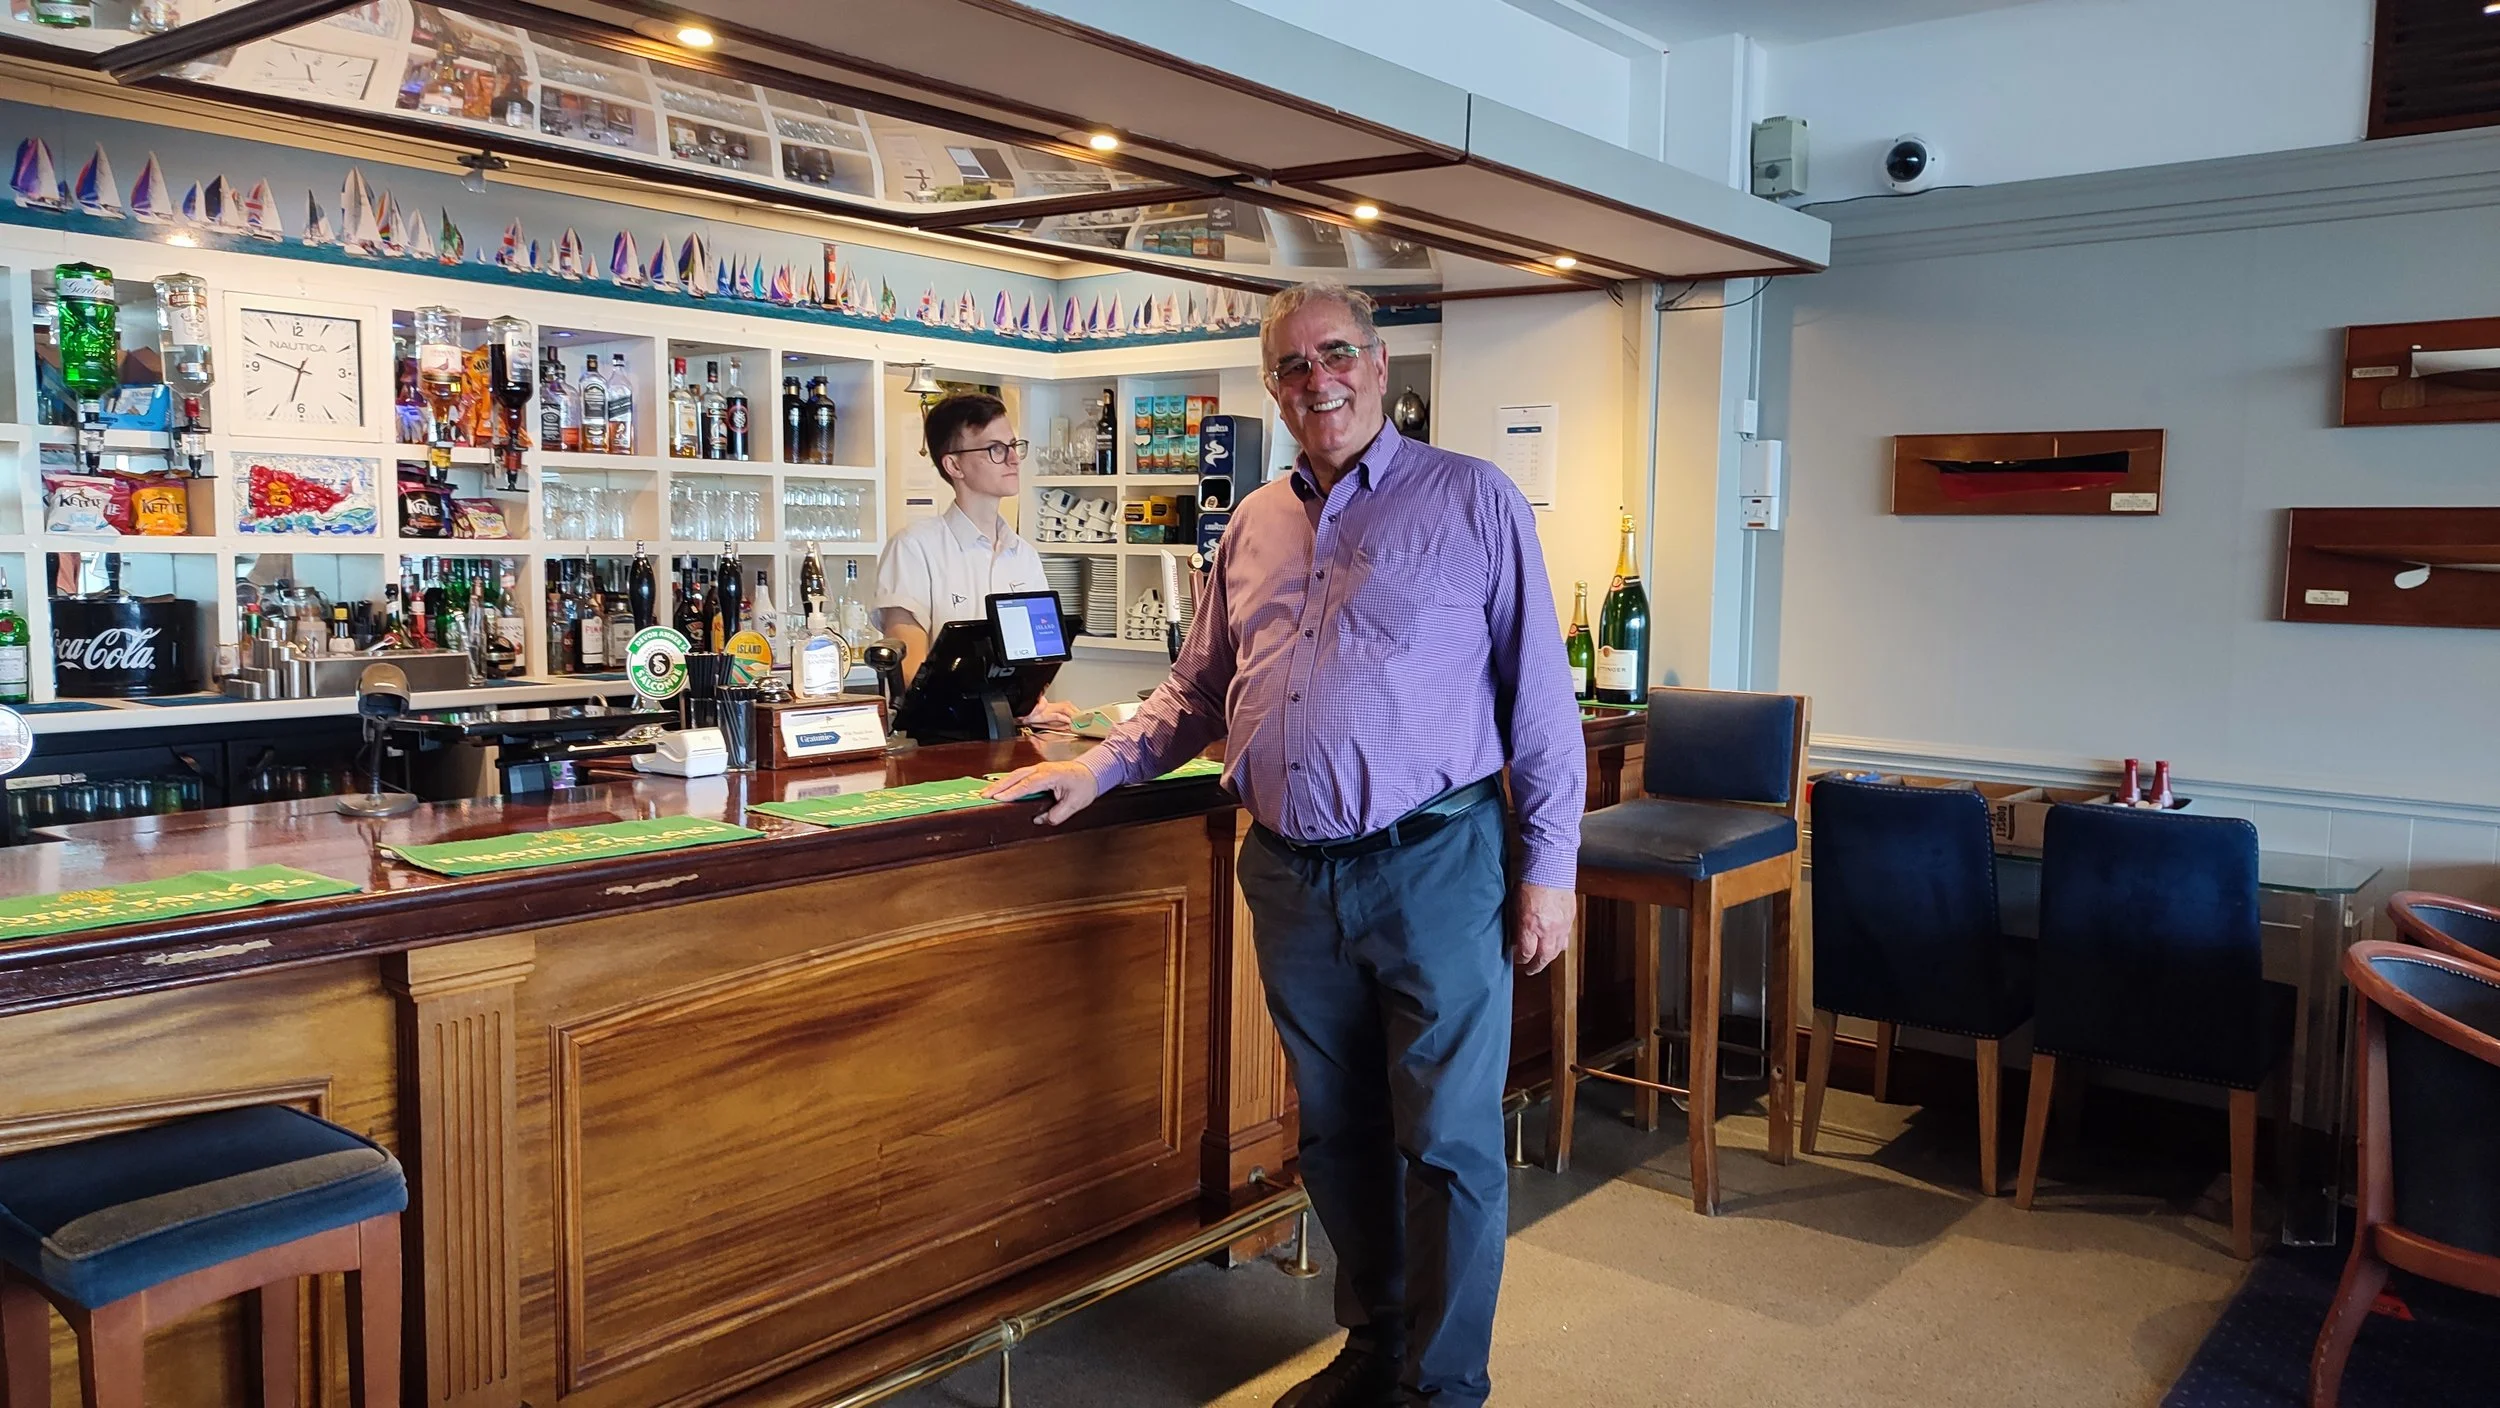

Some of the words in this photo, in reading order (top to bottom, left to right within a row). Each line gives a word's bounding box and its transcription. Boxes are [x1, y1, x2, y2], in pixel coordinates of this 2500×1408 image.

[292, 325, 304, 338] 12
[269, 340, 328, 353] NAUTICA
[251, 360, 260, 373] 9
[338, 367, 347, 379] 3
[296, 402, 306, 415] 6
[634, 631, 658, 647] DEVON
[659, 630, 683, 646] AMBER
[736, 644, 762, 655] ISLAND
[635, 667, 683, 691] SALCOMBE
